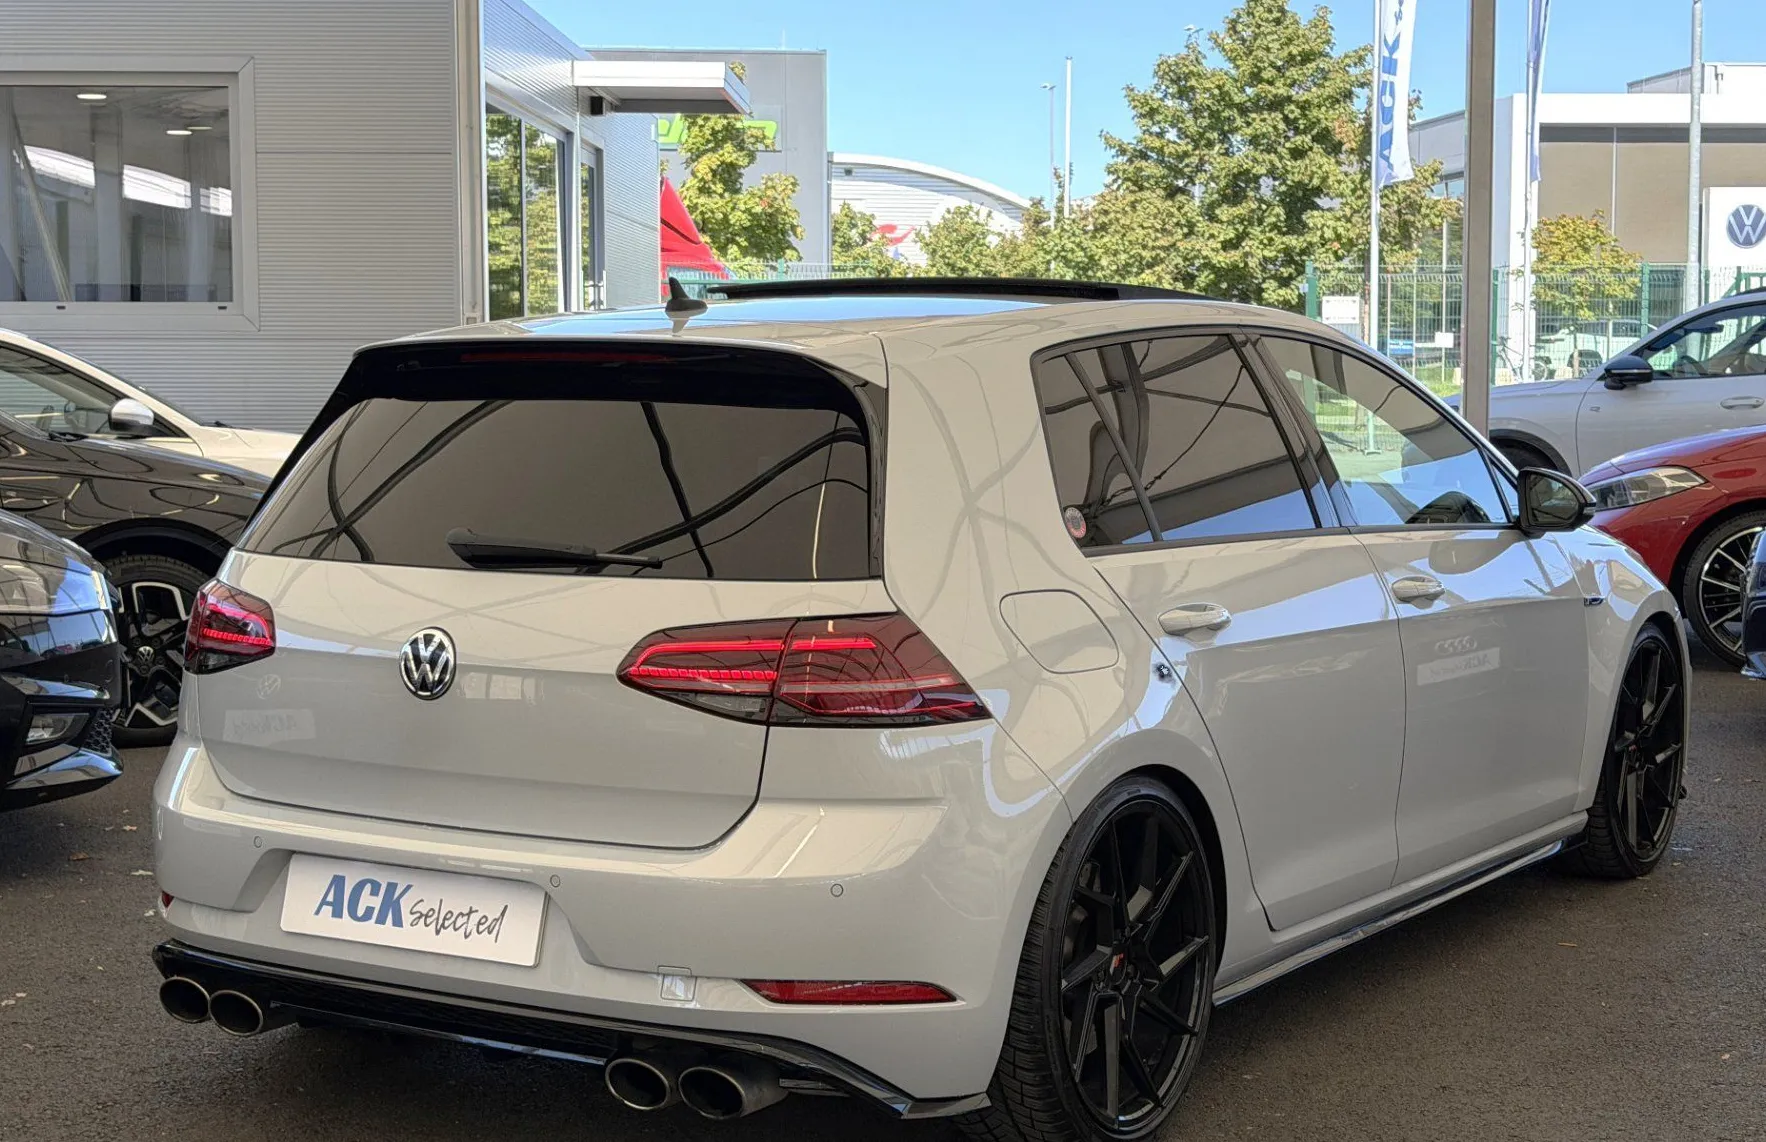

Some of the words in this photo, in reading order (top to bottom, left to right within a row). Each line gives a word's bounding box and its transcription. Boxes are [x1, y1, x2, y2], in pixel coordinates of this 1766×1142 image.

[1379, 32, 1401, 172] ACK
[1726, 204, 1766, 249] VW
[399, 626, 457, 701] VW
[313, 874, 413, 928] ACK
[409, 898, 509, 943] Selected
